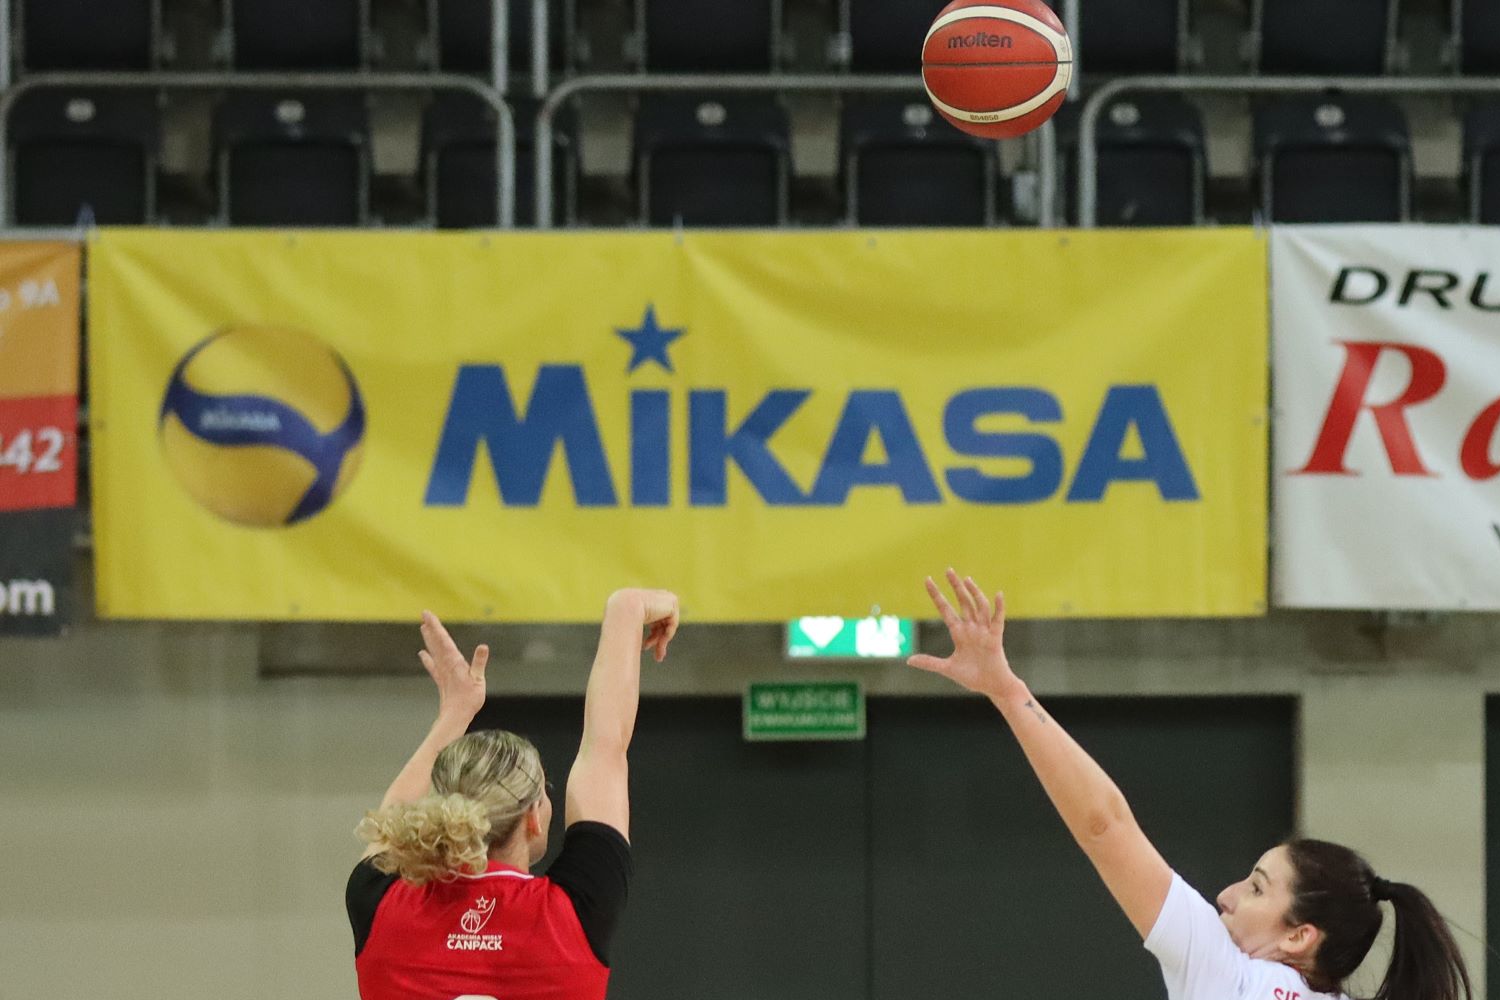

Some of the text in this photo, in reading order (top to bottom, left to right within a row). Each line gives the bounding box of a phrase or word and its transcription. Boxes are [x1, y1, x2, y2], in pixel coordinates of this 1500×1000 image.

[947, 32, 1012, 49] molten
[0, 578, 56, 616] m
[447, 940, 503, 951] CANPACK
